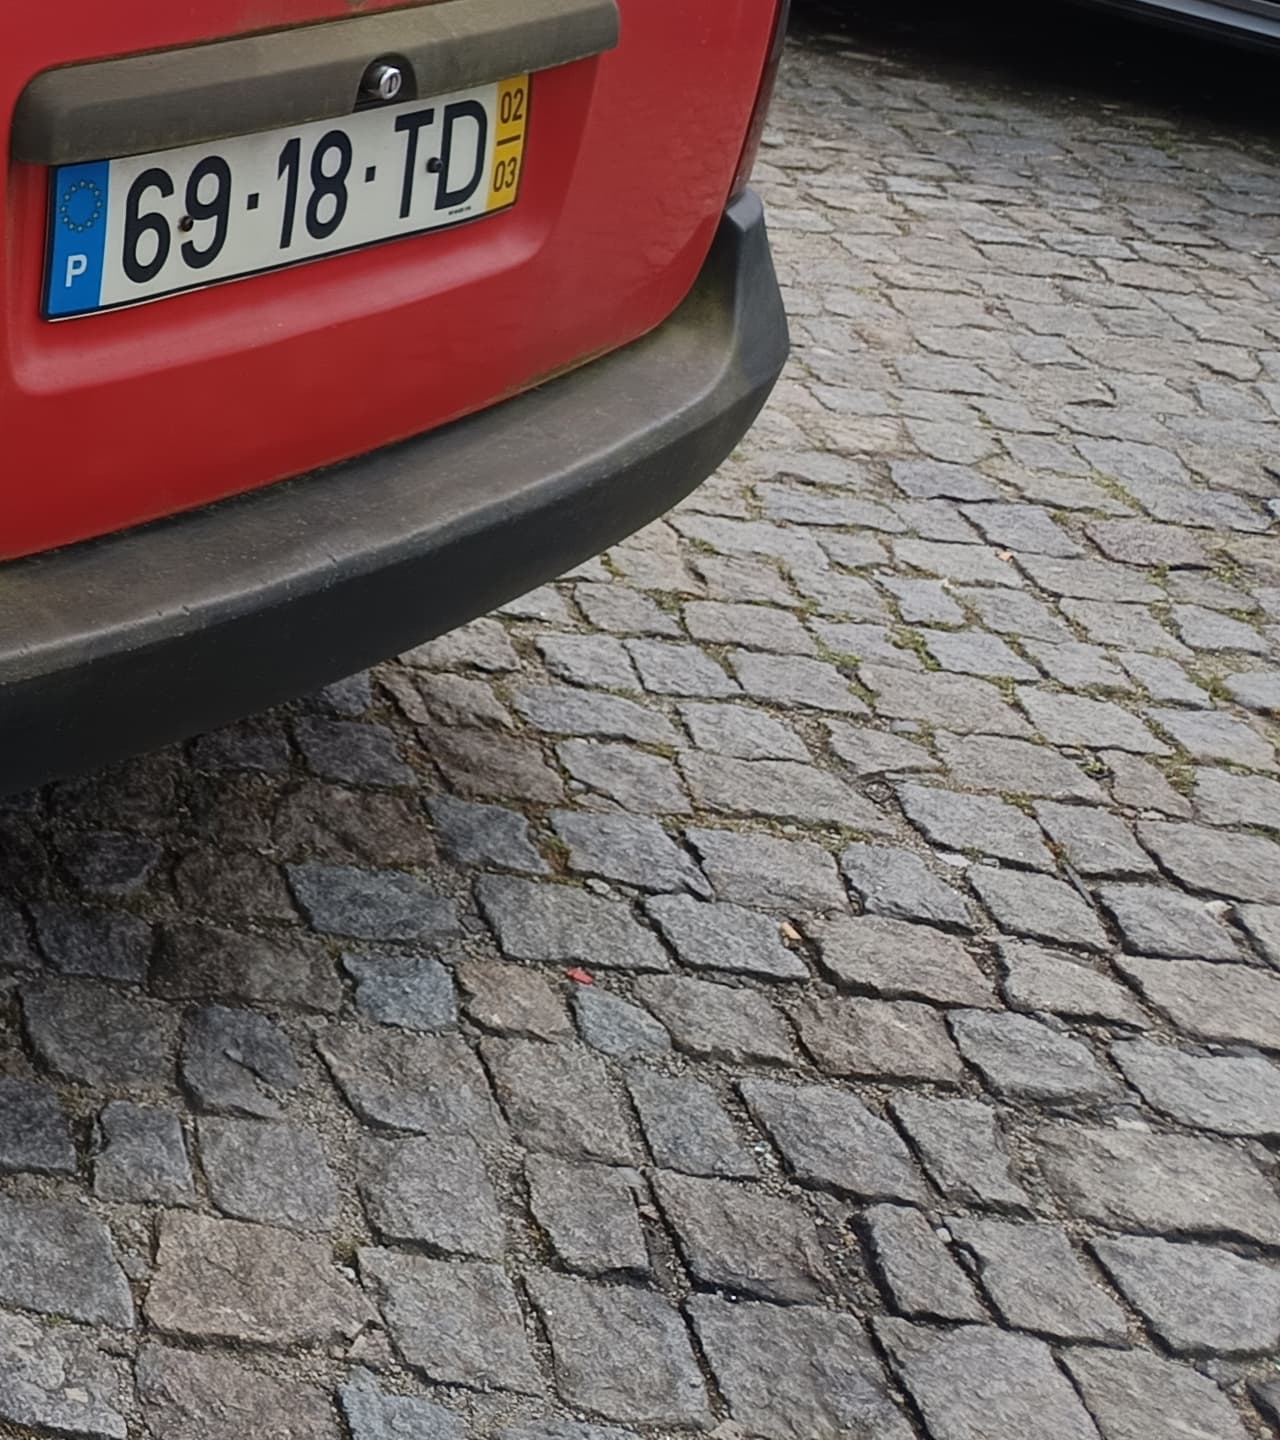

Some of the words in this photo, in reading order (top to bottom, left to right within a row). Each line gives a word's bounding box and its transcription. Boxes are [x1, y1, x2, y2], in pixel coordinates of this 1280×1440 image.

[500, 88, 524, 124] 02
[492, 156, 517, 193] 03
[64, 253, 88, 288] P
